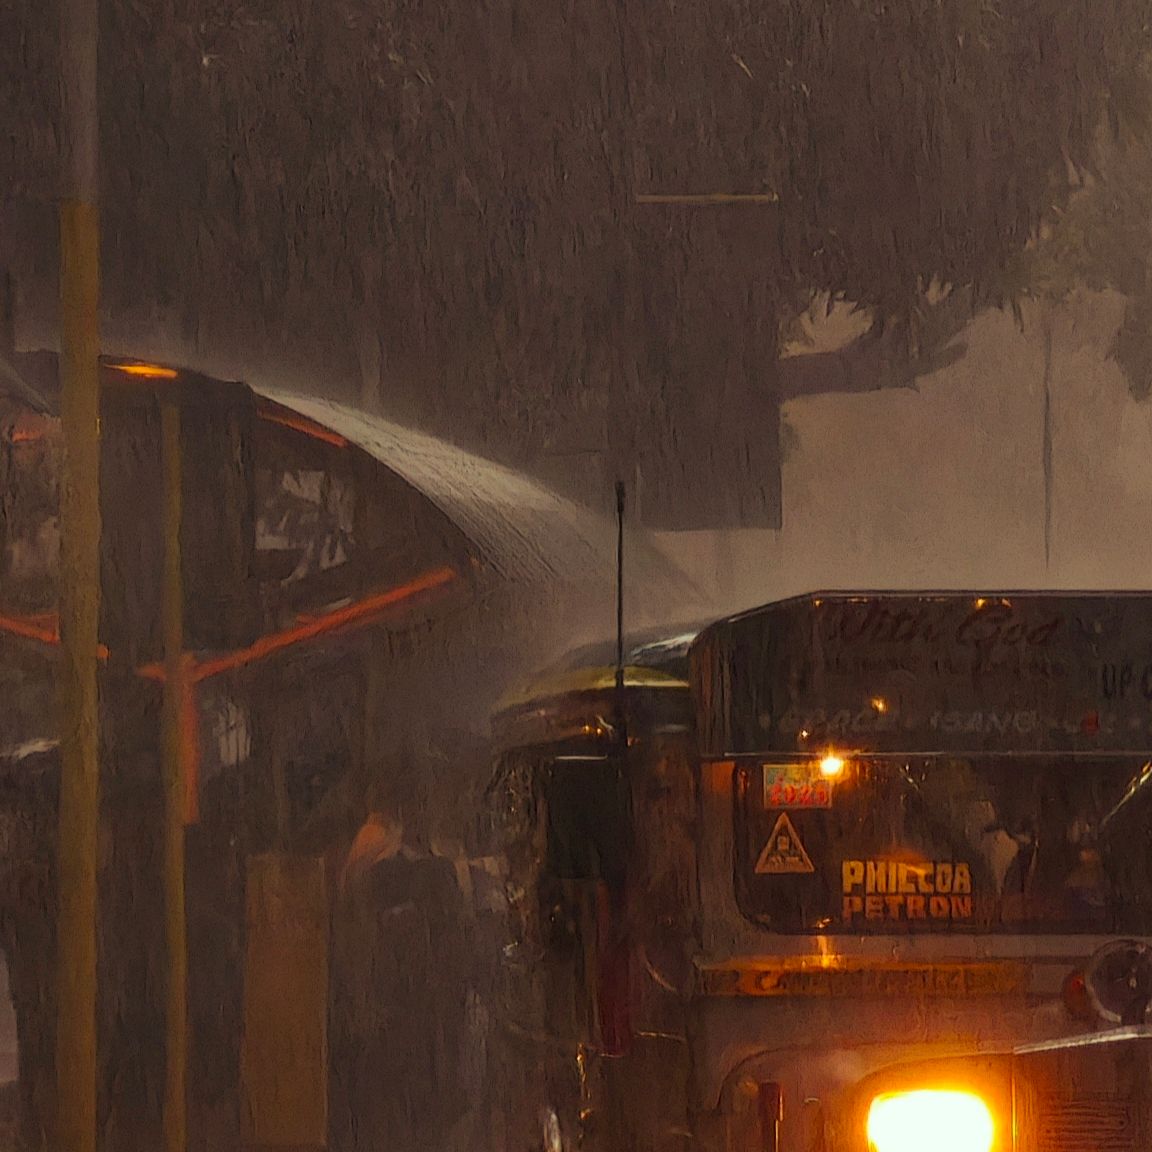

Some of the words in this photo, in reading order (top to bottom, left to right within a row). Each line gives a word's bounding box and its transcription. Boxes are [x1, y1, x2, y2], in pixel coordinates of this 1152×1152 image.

[957, 606, 1066, 646] God
[1101, 663, 1134, 701] UP
[842, 860, 972, 894] PHILCOA
[842, 895, 972, 920] PETRON
